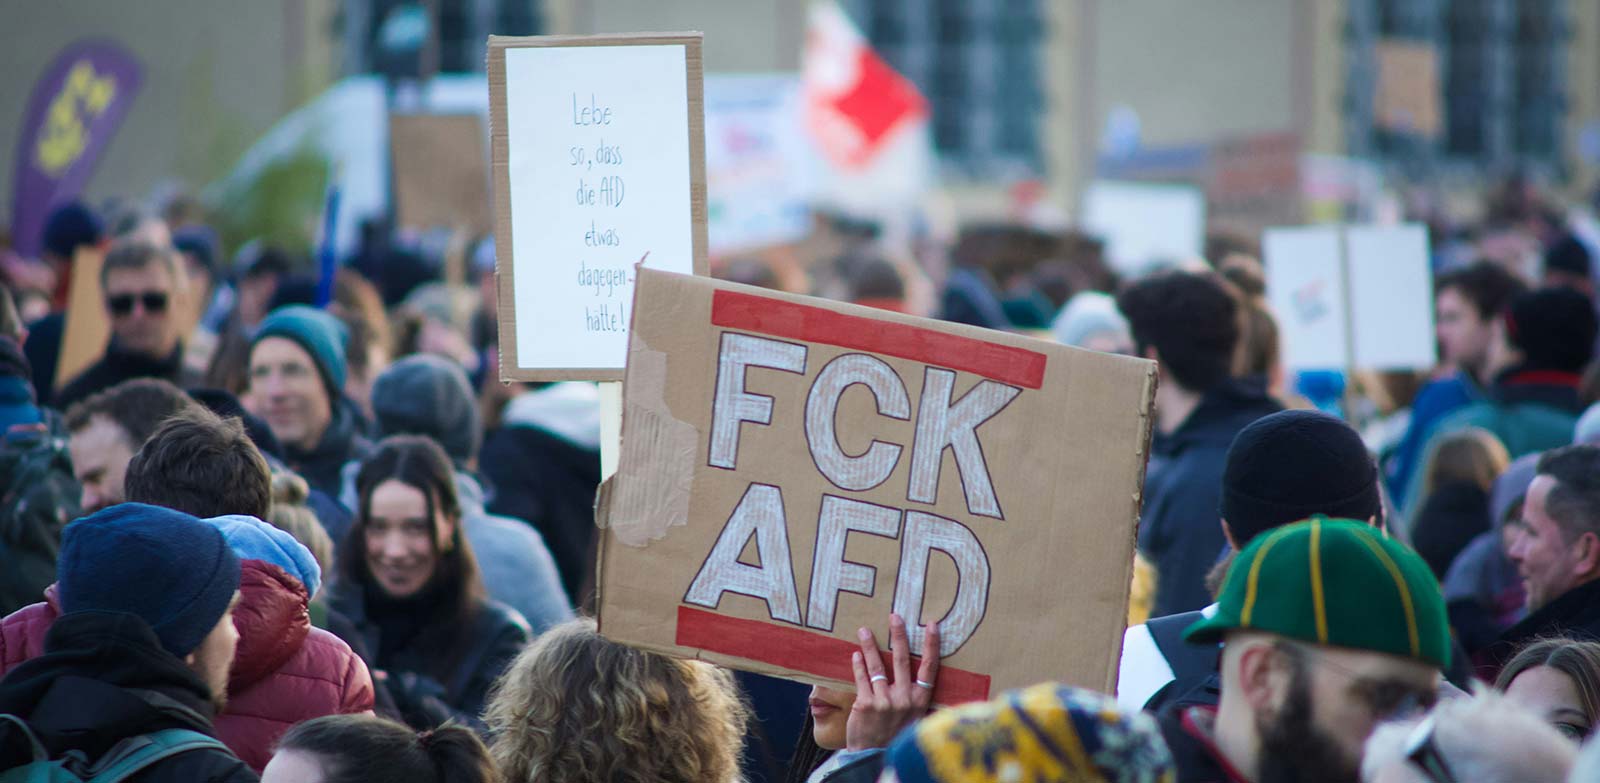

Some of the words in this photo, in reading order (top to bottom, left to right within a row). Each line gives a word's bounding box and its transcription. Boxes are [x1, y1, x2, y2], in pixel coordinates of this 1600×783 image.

[573, 92, 612, 125] Lebe
[571, 147, 592, 170] so,
[597, 139, 622, 166] dass
[577, 179, 596, 206] die
[600, 176, 624, 207] AfD
[585, 221, 620, 247] etwas
[578, 261, 626, 298] dagegen
[586, 302, 626, 332] hätte!
[708, 331, 1023, 520] FCK
[683, 482, 991, 659] AFD
